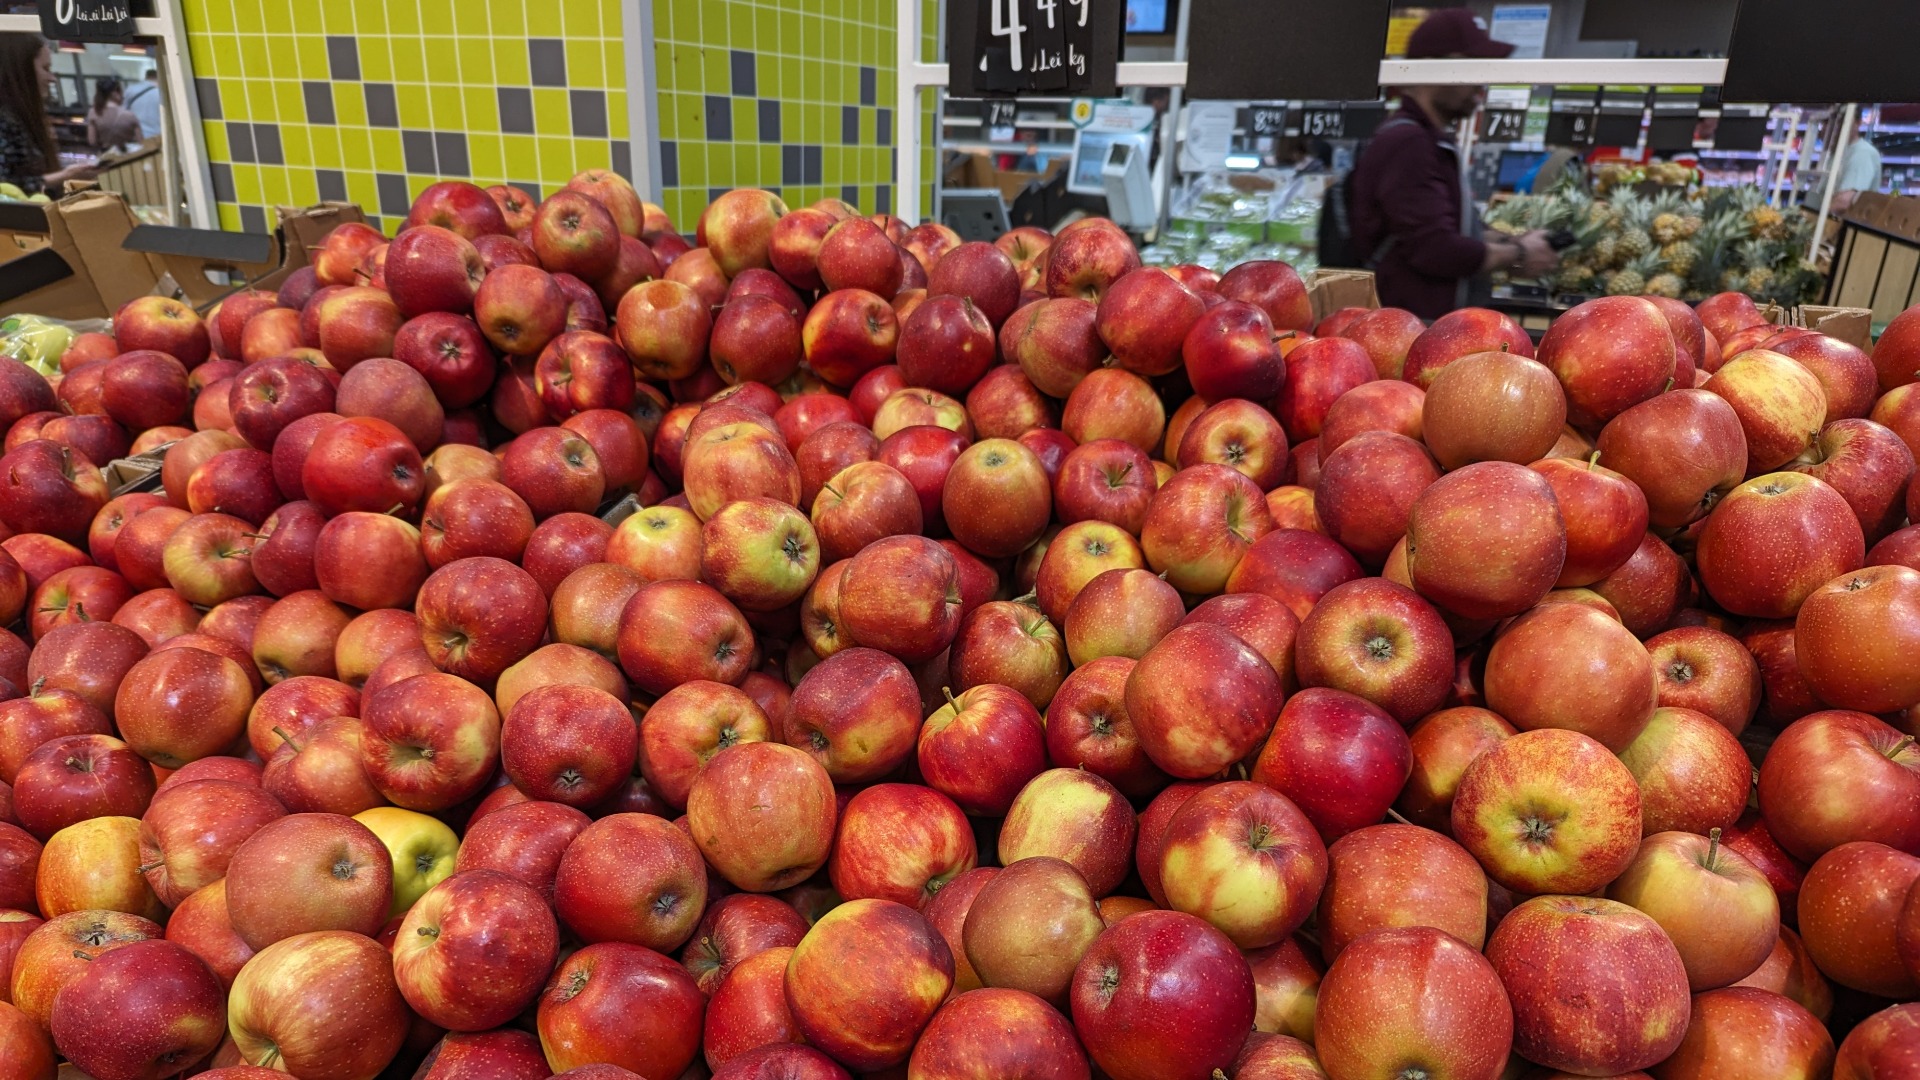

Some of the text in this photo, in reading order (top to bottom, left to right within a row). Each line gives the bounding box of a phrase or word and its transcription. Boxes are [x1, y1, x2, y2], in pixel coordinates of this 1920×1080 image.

[101, 4, 114, 21] Lei
[113, 6, 128, 24] Lei
[991, 0, 1028, 72] 4
[1039, 43, 1086, 76] Lei kg
